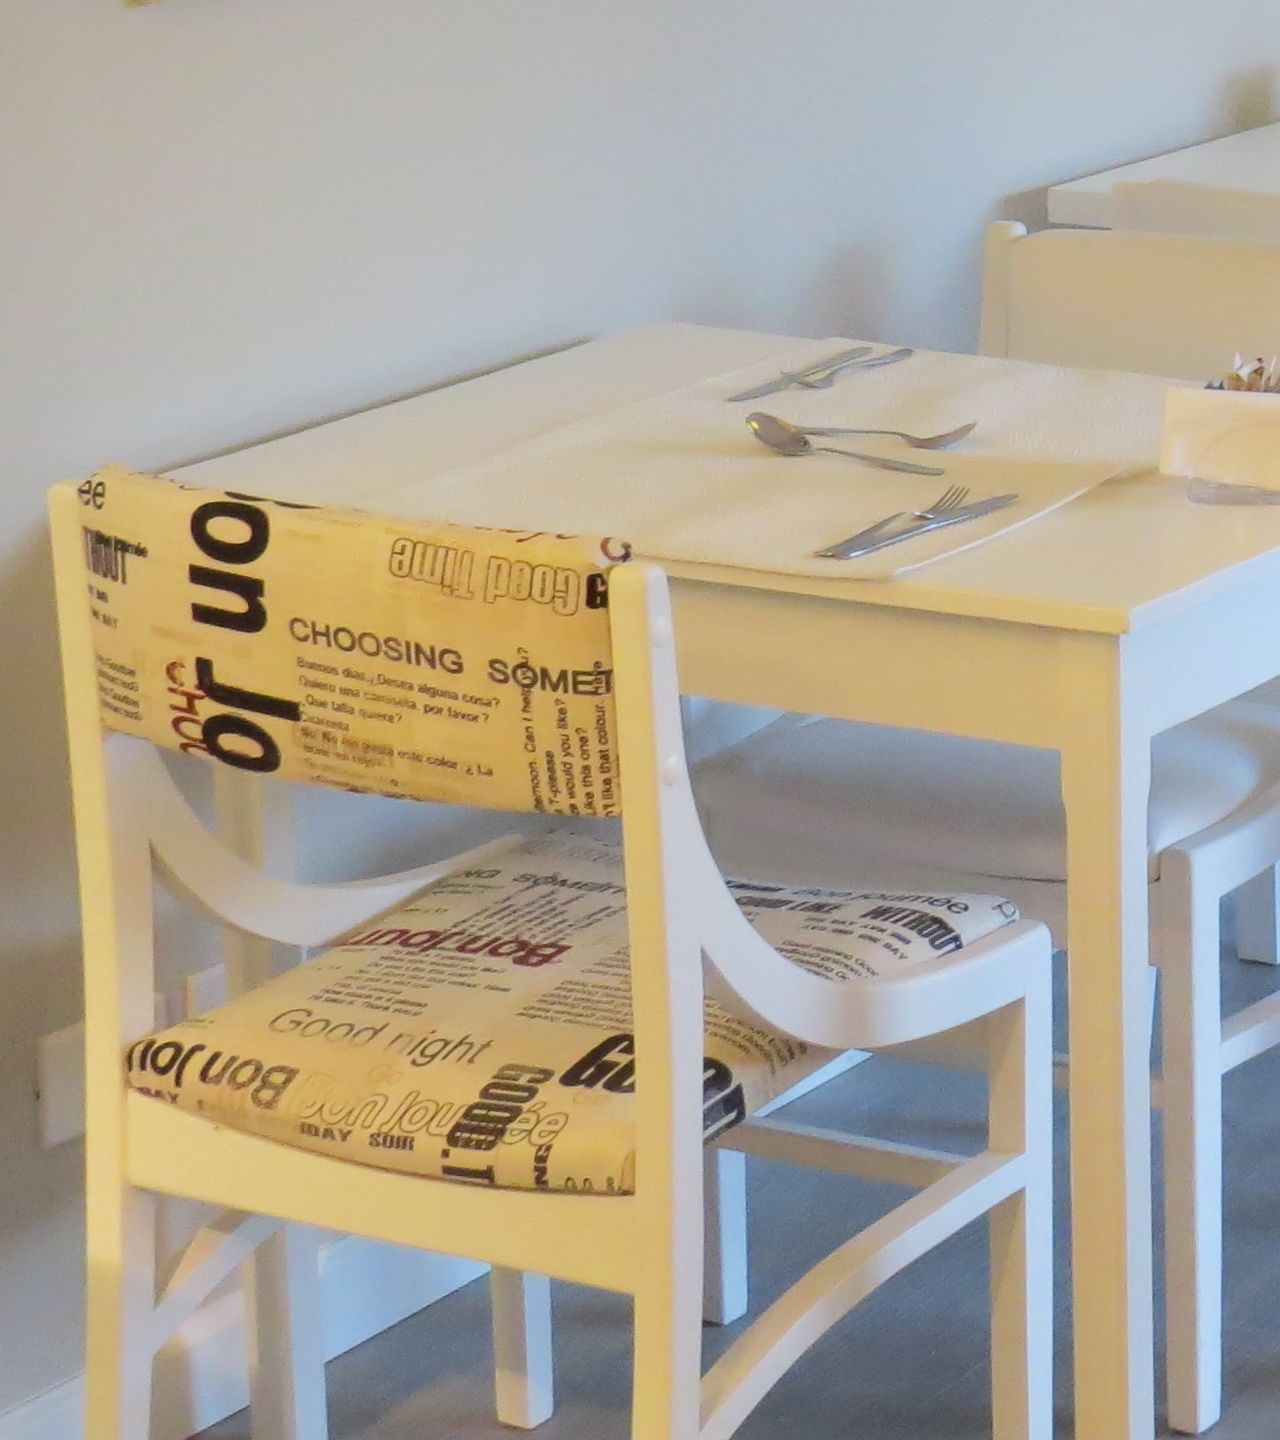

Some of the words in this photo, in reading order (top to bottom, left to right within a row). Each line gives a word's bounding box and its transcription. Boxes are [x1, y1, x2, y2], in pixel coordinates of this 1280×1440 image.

[289, 617, 464, 674] CHOOSING
[560, 733, 575, 757] you
[268, 1007, 391, 1048] Good
[386, 1030, 494, 1067] night
[200, 1051, 300, 1111] Bon
